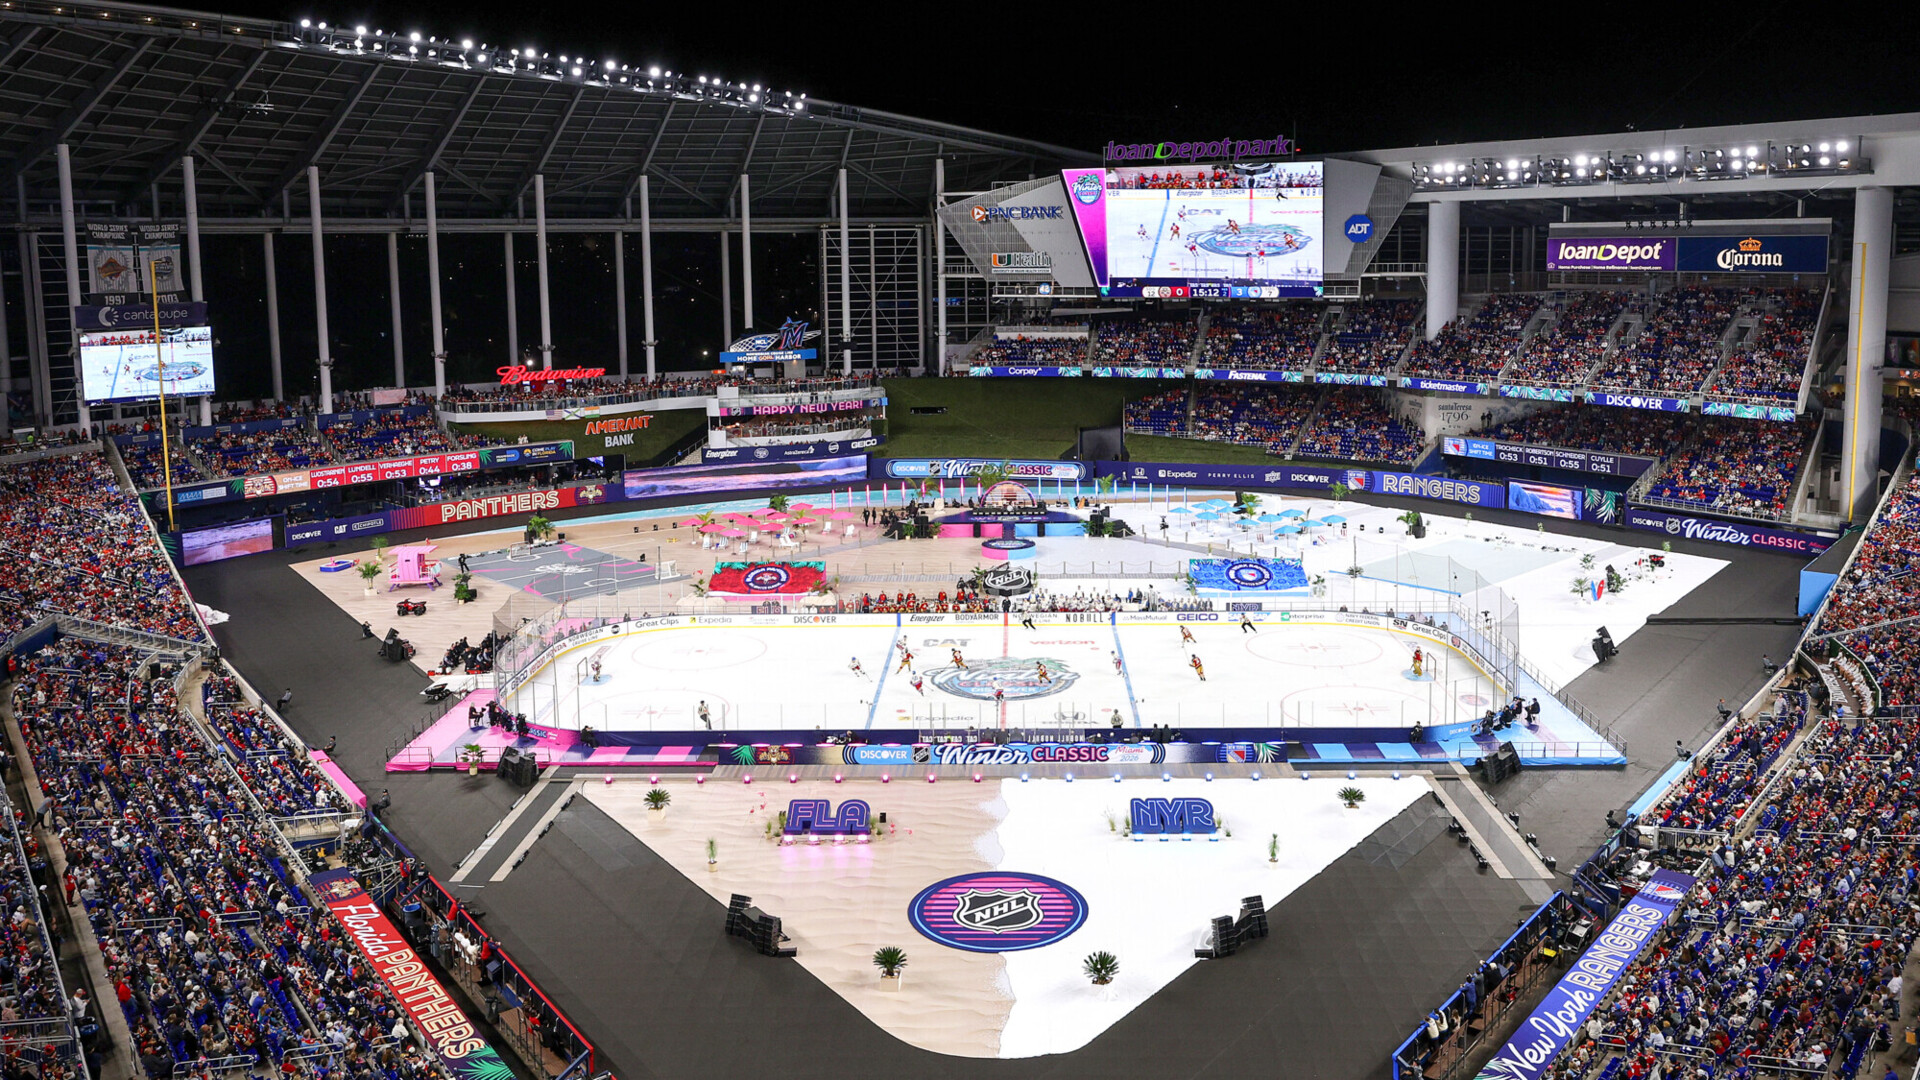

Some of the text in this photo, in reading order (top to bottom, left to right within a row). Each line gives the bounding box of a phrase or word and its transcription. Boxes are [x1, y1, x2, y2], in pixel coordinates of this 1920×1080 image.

[1106, 134, 1289, 162] loanDepot park
[1187, 208, 1222, 216] CAT
[87, 224, 108, 232] WORLD
[92, 232, 126, 240] CHAMPIONS
[1348, 223, 1370, 234] ADT
[1558, 242, 1663, 264] loanDepot
[1716, 248, 1783, 271] Corona
[104, 296, 126, 305] 1997
[123, 310, 188, 320] cantaoupe
[496, 364, 606, 385] Budweiser
[1008, 367, 1039, 377] Corpay
[1228, 370, 1266, 381] FASTENAL
[1420, 380, 1467, 392] ticketmaster
[753, 400, 863, 415] HAPPY NEW YEAR!
[1606, 394, 1662, 410] DISCOVER
[585, 416, 650, 435] AMERANT
[1441, 412, 1469, 424] 1796
[605, 434, 634, 448] BANK
[705, 450, 738, 459] Energizer
[851, 438, 877, 449] GEICO
[1496, 444, 1614, 464] TROCHECK ROBERTSON SCHNEIDER CUYLLE
[348, 465, 376, 473] LUNDELL
[379, 460, 412, 469] VERHAEGHE
[419, 457, 440, 465] PETRY
[447, 453, 477, 461] FORSLING
[1004, 464, 1052, 475] CLASSIC
[1500, 452, 1611, 473] 0:53 0:51 0:55 0:51
[317, 462, 472, 488] 0:54 0:55 0:53 0:44 0:38
[1167, 470, 1197, 478] Expedia
[1291, 473, 1329, 484] DISCOVER
[1383, 474, 1480, 503] RANGERS
[442, 491, 559, 522] PANTHERS
[292, 520, 382, 540] DISCOVER CAT CHIPOTLE
[1633, 517, 1663, 528] DISCOVER
[1682, 518, 1750, 546] Winter
[1752, 534, 1806, 550] CLASSIC
[995, 572, 1020, 585] NHL
[635, 619, 658, 628] Great
[660, 618, 679, 626] Clips
[698, 616, 732, 624] Expedia
[794, 616, 837, 624] DISCOVER
[910, 614, 945, 623] Energizer
[1066, 614, 1104, 623] NOBULL
[1176, 613, 1218, 621] GEICO
[568, 628, 603, 642] NORWEGIAN
[1412, 623, 1432, 635] Great
[1432, 628, 1446, 640] Clips
[923, 638, 971, 647] CAT
[528, 728, 547, 738] ASSIC
[860, 745, 1109, 764] DISCOVER Winter CLASSIC
[1116, 746, 1144, 754] Miami
[1120, 754, 1139, 762] 2026
[786, 799, 870, 831] FLA
[1130, 798, 1214, 832] NYR
[974, 898, 1026, 922] NHL
[1565, 903, 1664, 991] RANGERS
[332, 903, 487, 1060] Florida PANTHERS
[1500, 986, 1596, 1080] New York
